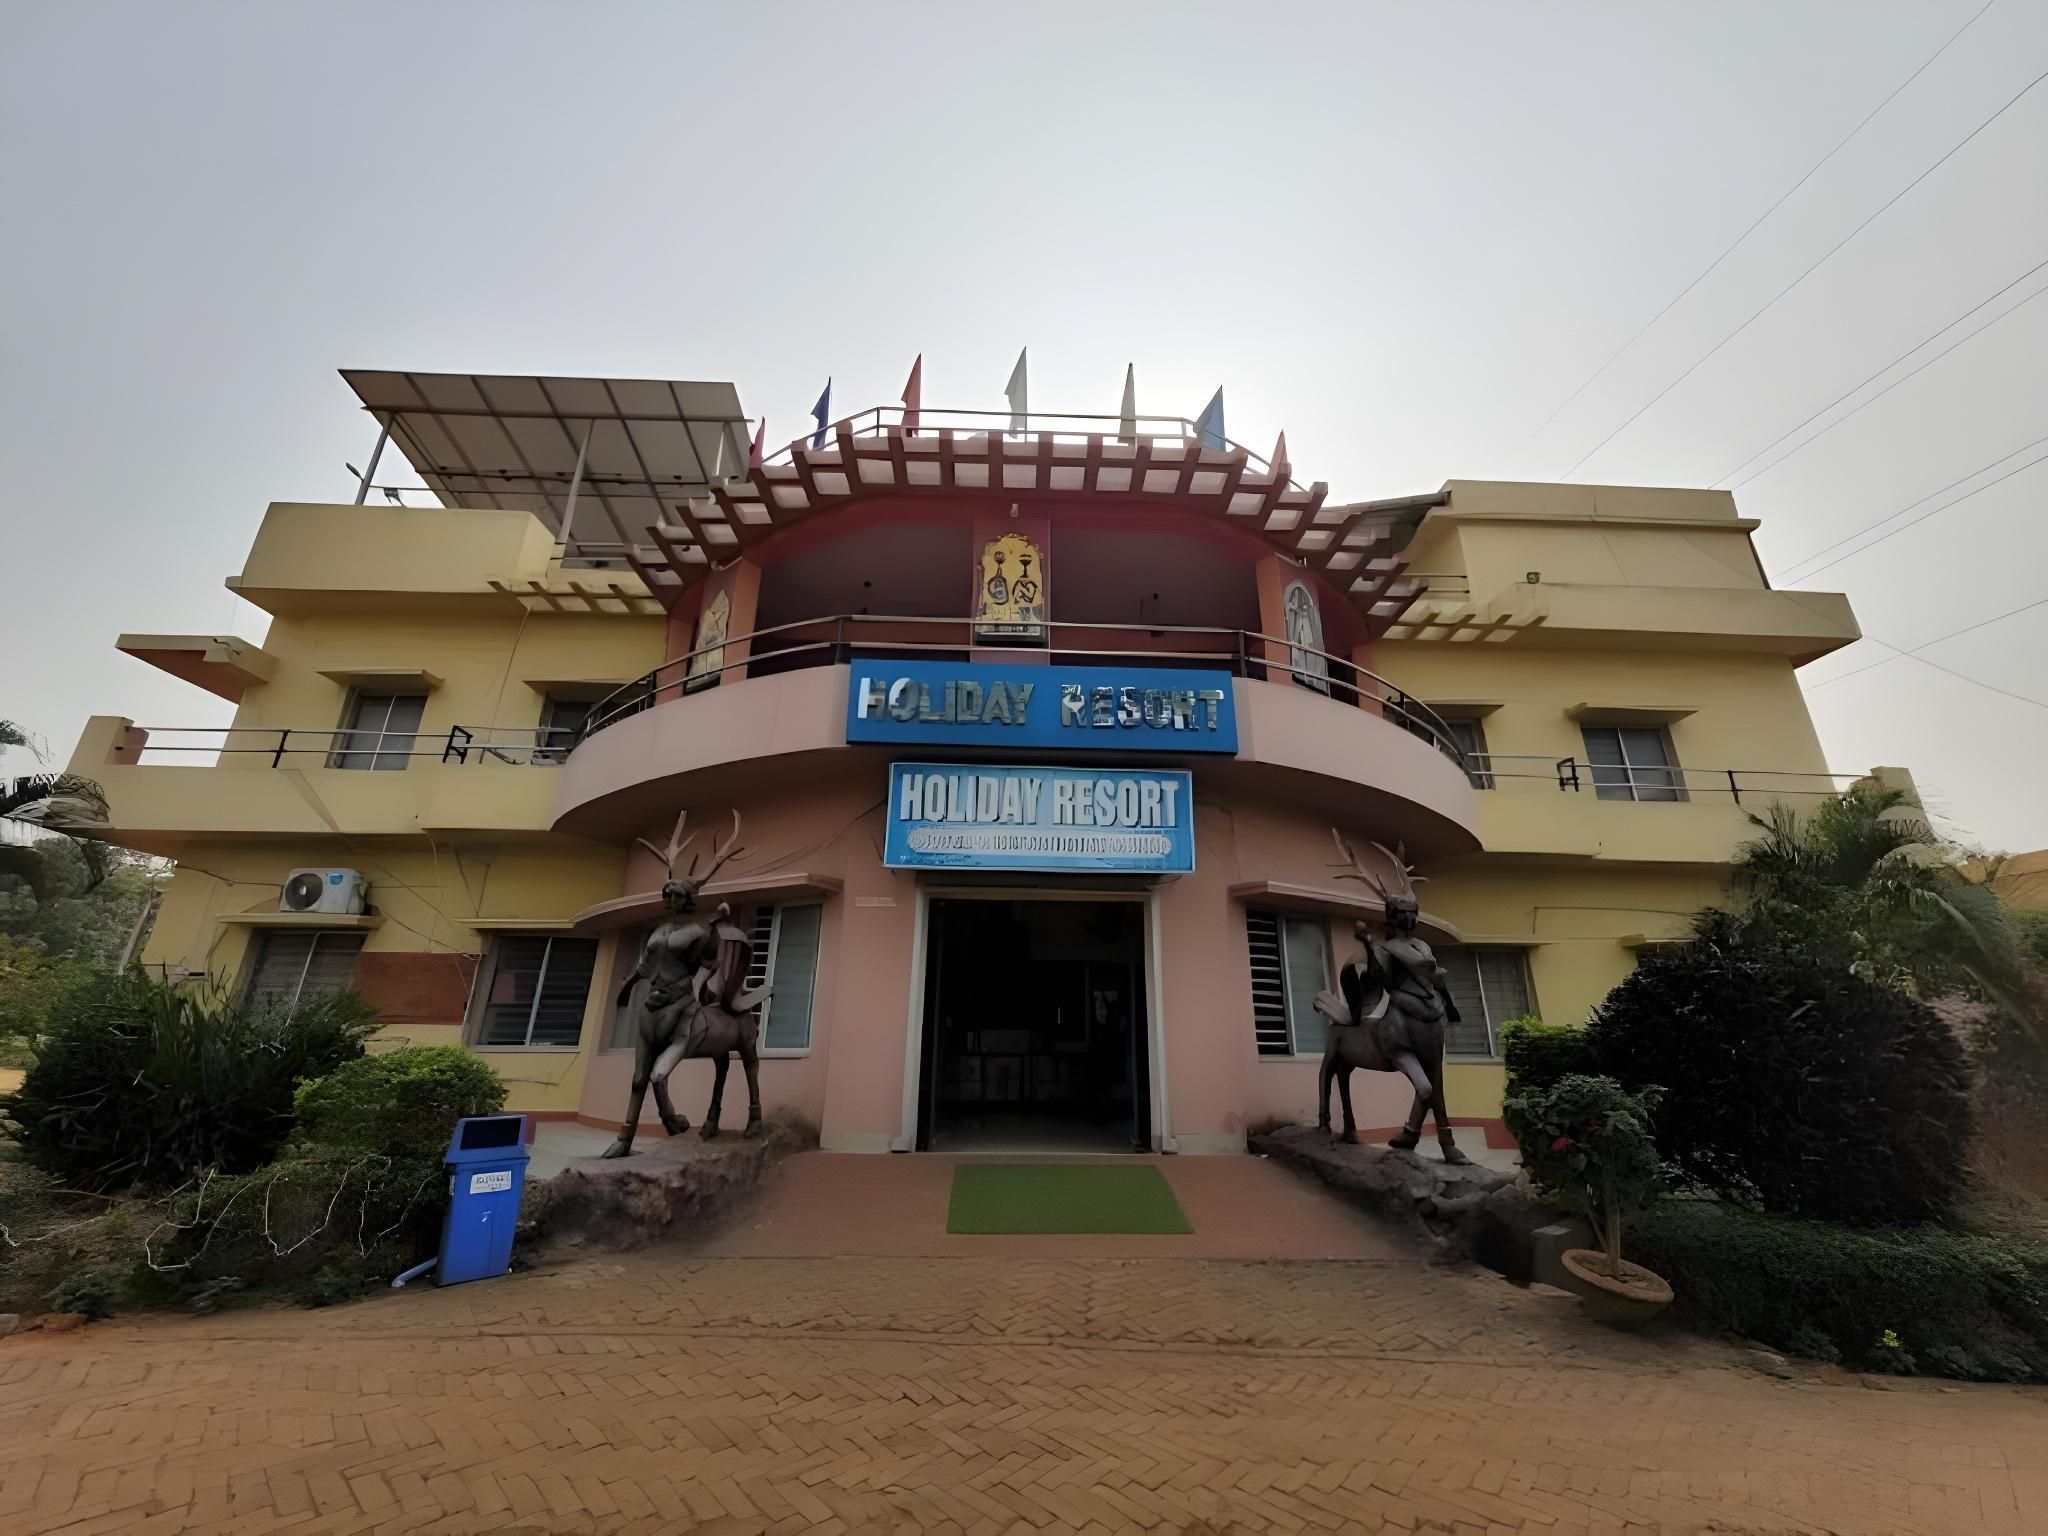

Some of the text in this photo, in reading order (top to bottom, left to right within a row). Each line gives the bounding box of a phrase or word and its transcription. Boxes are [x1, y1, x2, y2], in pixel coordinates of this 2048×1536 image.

[857, 677, 1224, 731] HOLIDAY RESORT
[900, 773, 1179, 828] HOLIDAY RESORT
